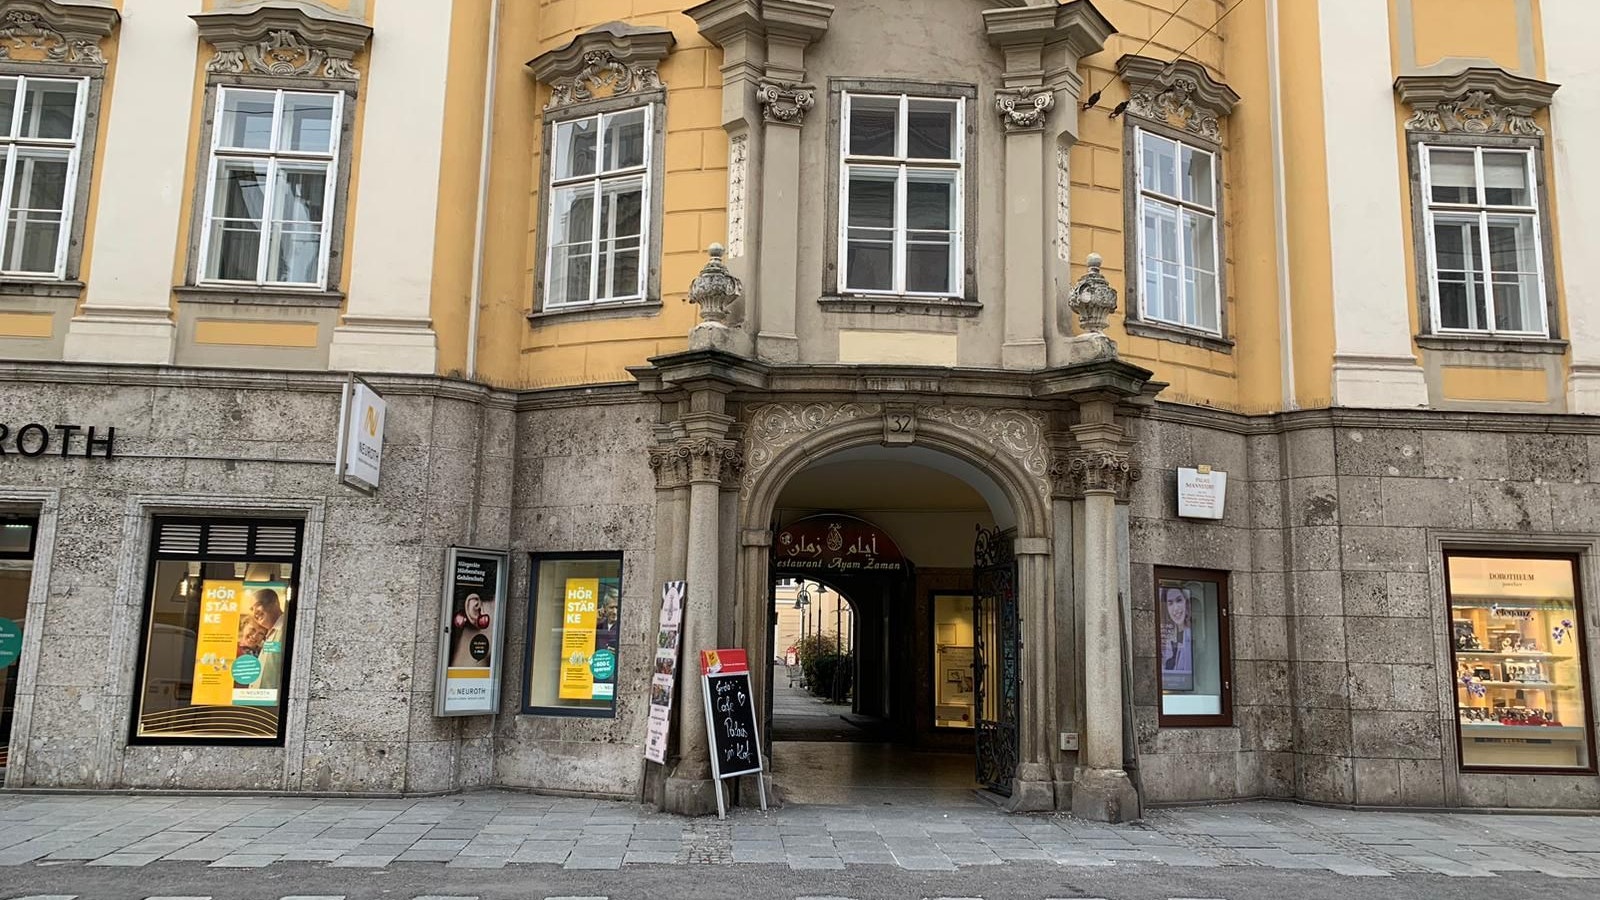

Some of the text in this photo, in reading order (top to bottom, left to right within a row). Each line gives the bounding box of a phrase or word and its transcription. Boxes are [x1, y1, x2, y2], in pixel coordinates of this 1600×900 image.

[890, 414, 911, 433] 32
[787, 533, 880, 558] أيام زمان
[777, 557, 901, 572] estaurant Ayam Zaman
[1489, 573, 1534, 581] DOROTHEUM
[207, 586, 235, 600] HÖR
[568, 586, 593, 600] HÖR
[206, 599, 238, 613] STÄR
[567, 600, 595, 612] STÄR
[204, 613, 222, 624] KE
[567, 613, 582, 624] KE
[457, 687, 486, 695] NEUROTH
